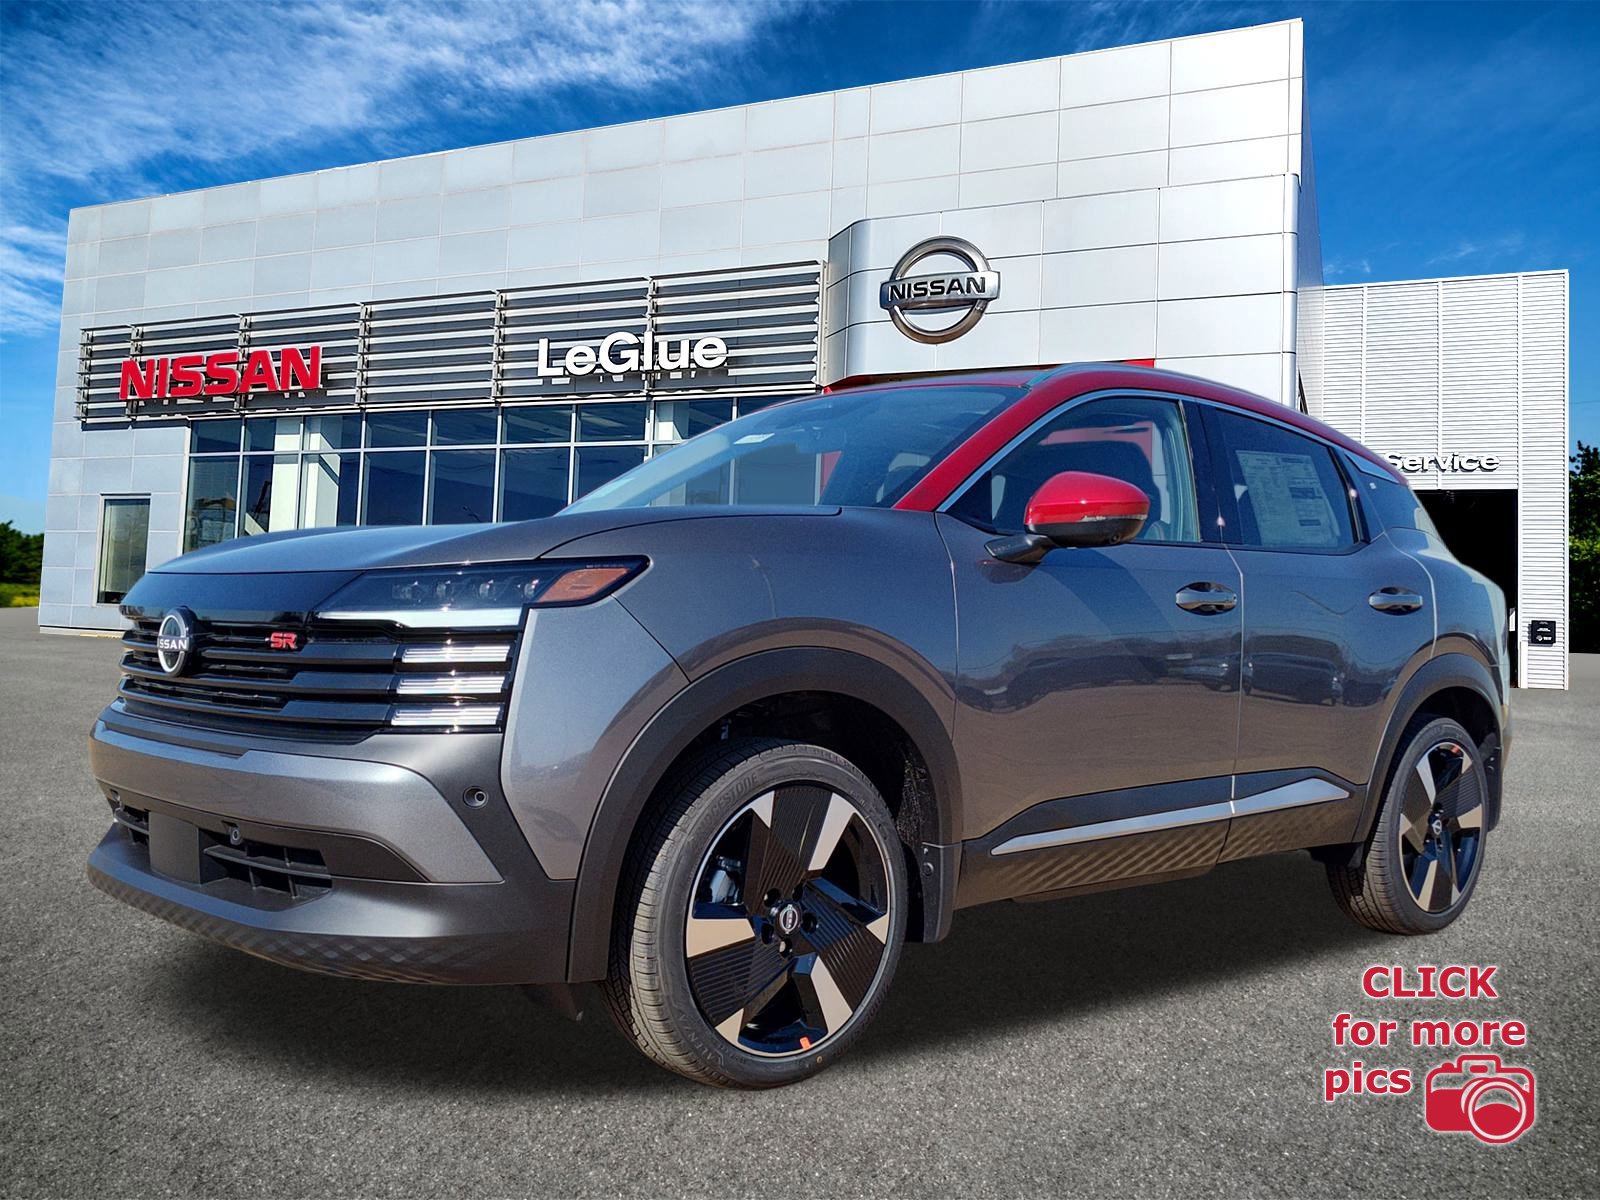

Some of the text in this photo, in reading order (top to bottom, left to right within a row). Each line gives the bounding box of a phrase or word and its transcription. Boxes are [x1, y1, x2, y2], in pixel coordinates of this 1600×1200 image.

[888, 277, 986, 300] NISSAN
[537, 331, 728, 376] LeGlue
[119, 346, 322, 400] NISSAN
[1383, 451, 1500, 472] Service
[158, 638, 187, 649] SSAN
[270, 632, 298, 649] SR
